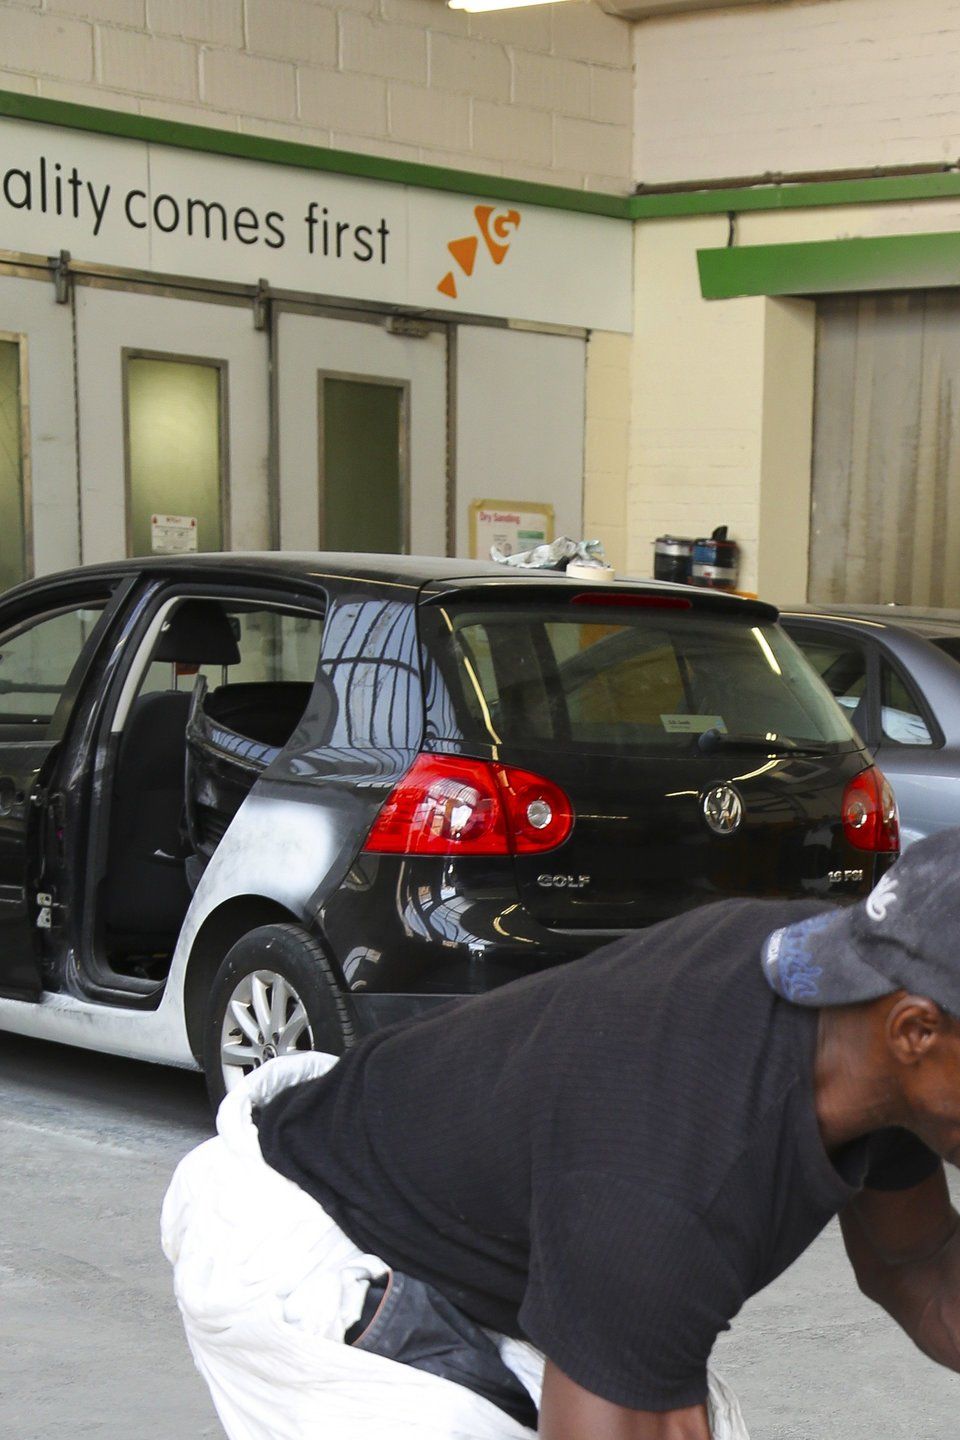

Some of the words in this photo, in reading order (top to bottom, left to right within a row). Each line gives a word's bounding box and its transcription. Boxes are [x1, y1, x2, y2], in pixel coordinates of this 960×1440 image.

[3, 156, 111, 236] ality
[124, 189, 286, 249] comes
[304, 202, 390, 265] first
[537, 874, 590, 888] GOLF
